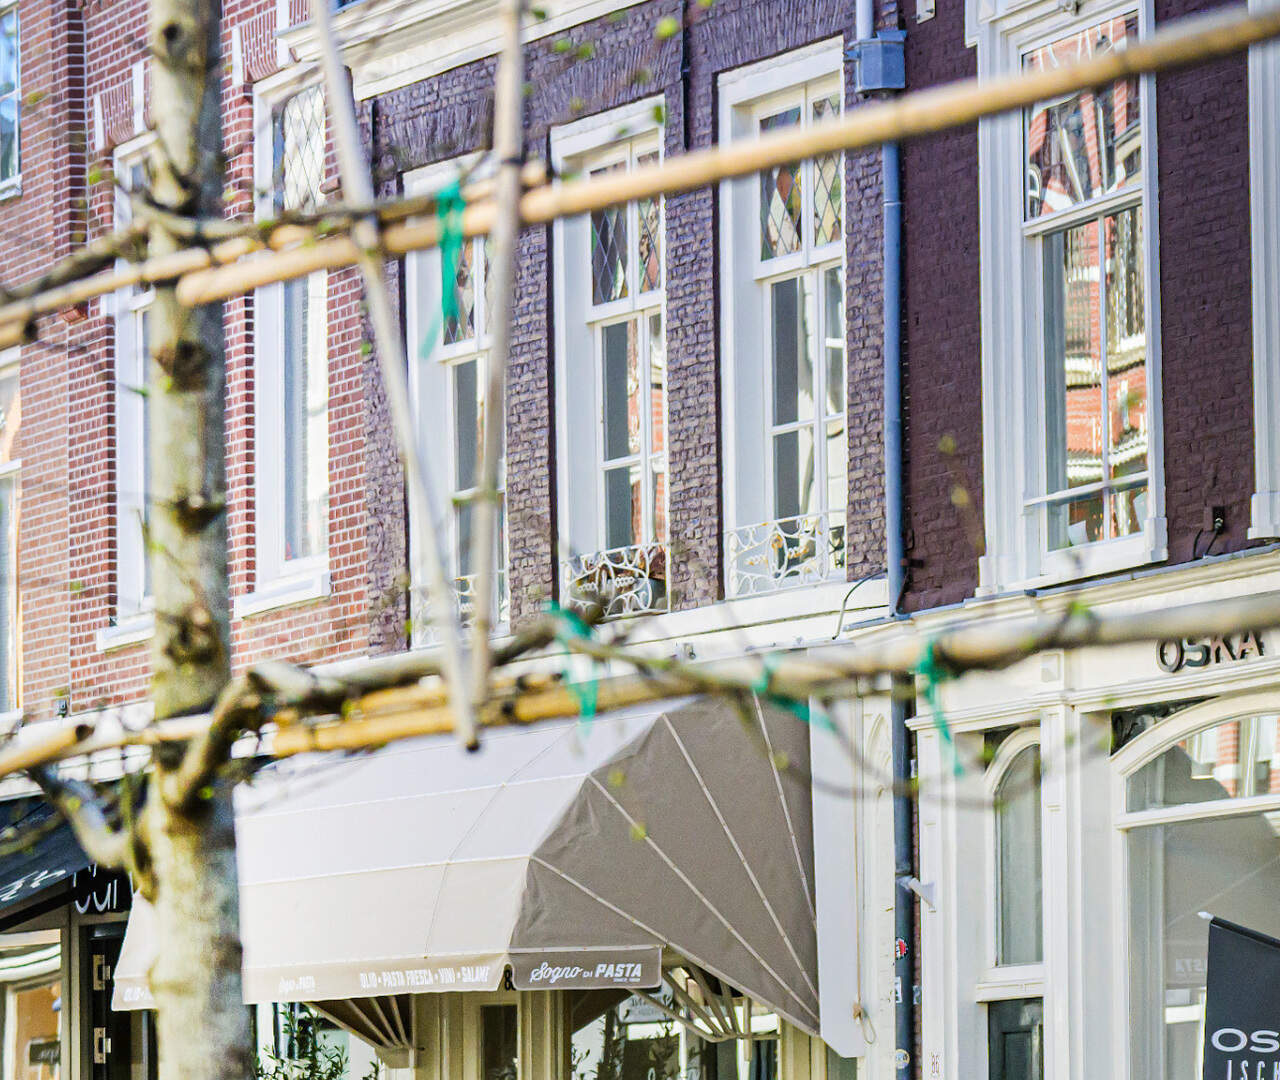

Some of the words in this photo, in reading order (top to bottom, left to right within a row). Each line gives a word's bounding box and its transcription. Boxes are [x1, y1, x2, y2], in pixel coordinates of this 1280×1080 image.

[1156, 629, 1264, 673] OSKA
[530, 962, 583, 984] Sogno
[594, 963, 642, 978] PASTA
[931, 1054, 940, 1074] 86
